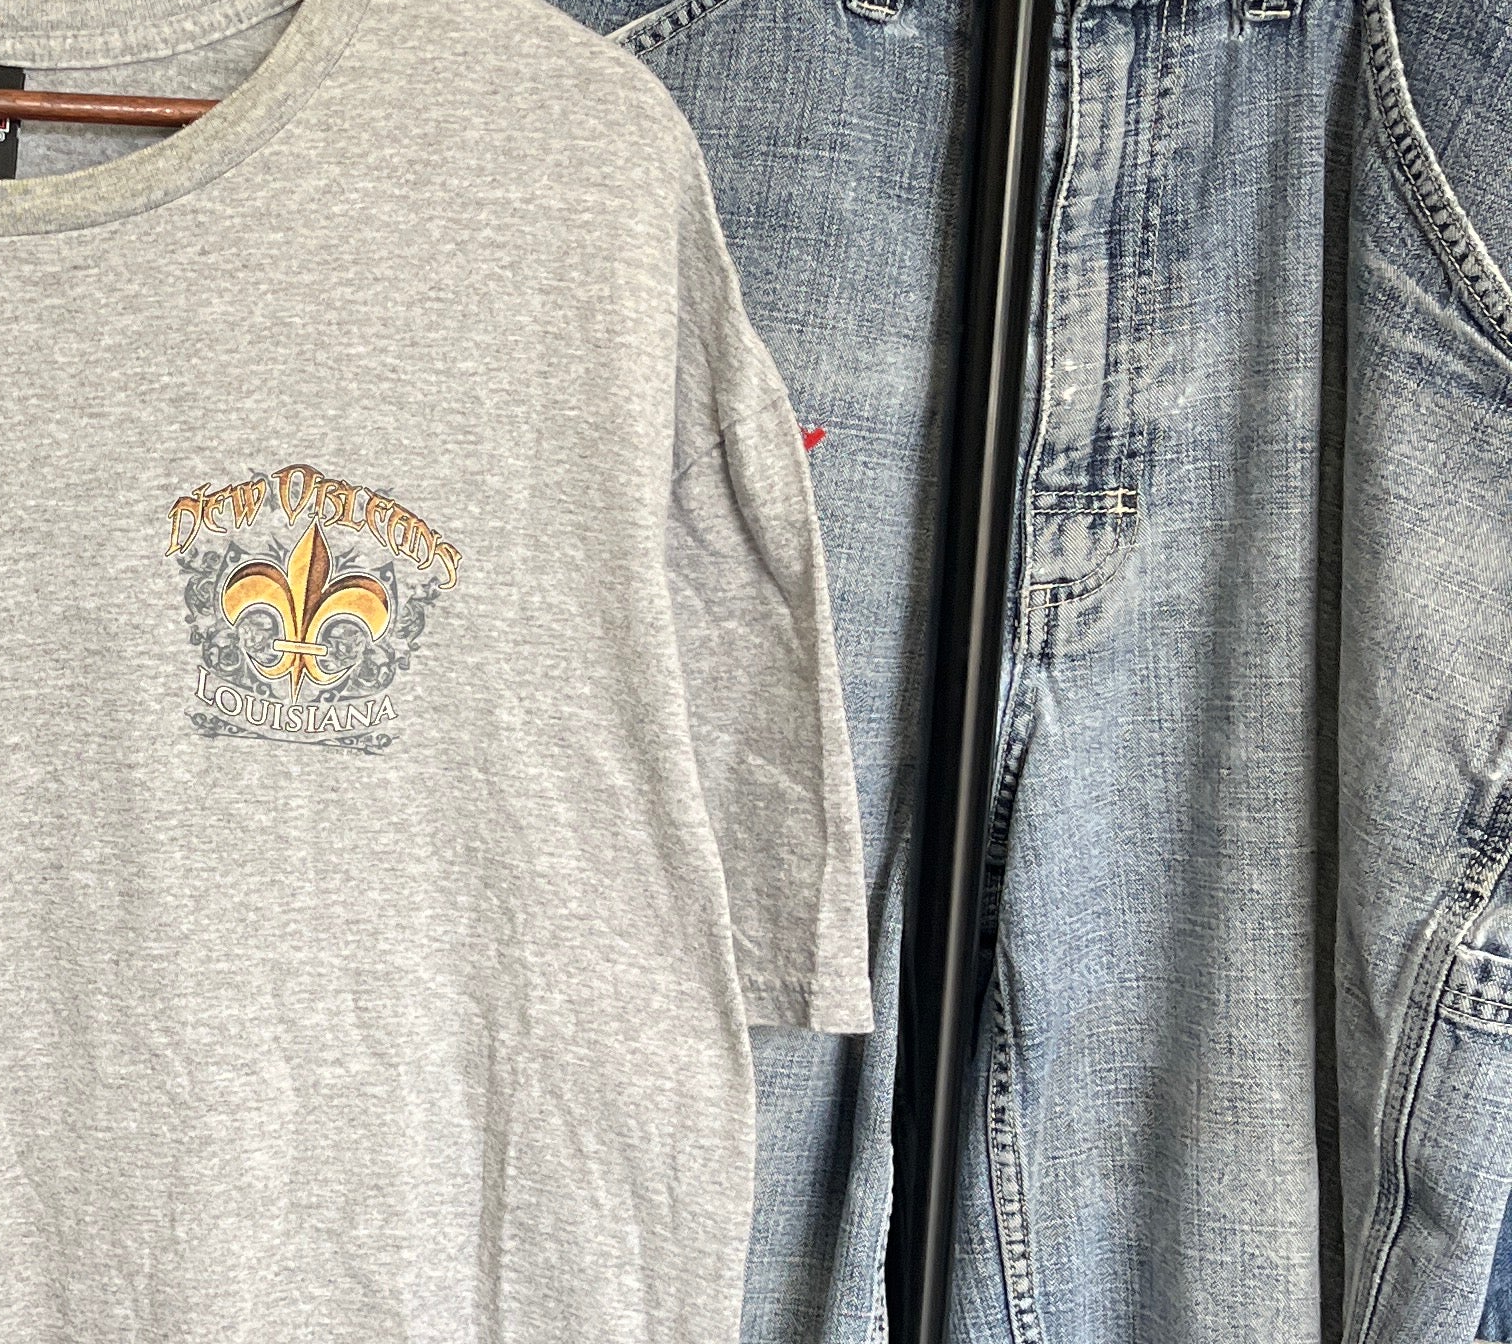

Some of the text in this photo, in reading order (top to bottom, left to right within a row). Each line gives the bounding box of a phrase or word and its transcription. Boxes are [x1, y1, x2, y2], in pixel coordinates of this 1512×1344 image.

[165, 463, 463, 590] NEW ORLEANS
[194, 665, 398, 733] LOUISIANA
